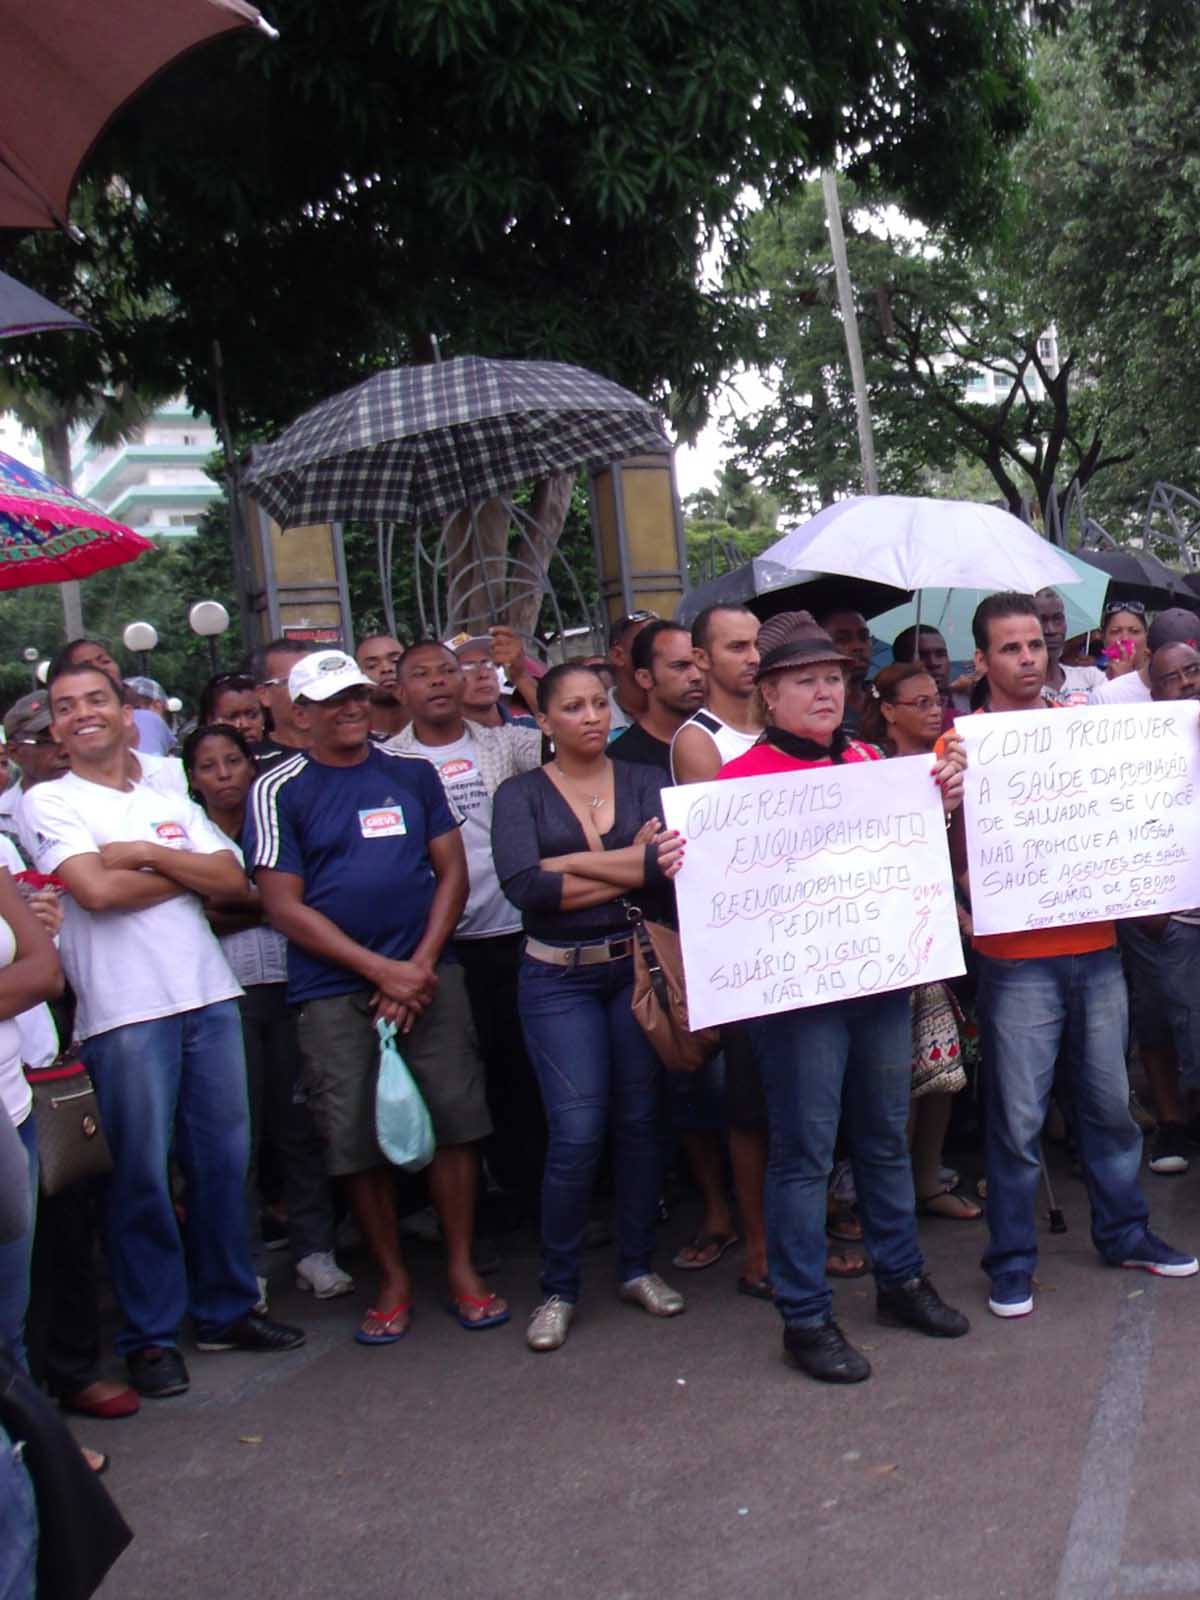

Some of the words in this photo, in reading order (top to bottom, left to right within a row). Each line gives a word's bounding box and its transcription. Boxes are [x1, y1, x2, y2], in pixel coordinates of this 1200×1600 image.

[977, 725, 1051, 766] COMO
[1067, 716, 1179, 748] PROMOVER
[978, 776, 991, 805] A
[1008, 761, 1083, 799] SAÚDE
[366, 816, 398, 828] GREVE
[686, 782, 843, 840] QUEREMOS
[978, 815, 1004, 835] DE
[1015, 801, 1103, 829] SALVADOR
[1110, 796, 1135, 813] SE
[1144, 784, 1193, 811] VOCÊ
[729, 812, 926, 866] ENQUADRAMENTO
[980, 840, 1014, 867] NÃO
[711, 865, 912, 920] REENQUADRAMENTO
[982, 862, 1049, 897] SAÚDE
[1059, 856, 1128, 883] AGENTES
[1132, 852, 1153, 866] DE
[1103, 880, 1121, 895] DE
[769, 901, 881, 943] PEDIMOS
[709, 947, 796, 991] SALÁRIO
[804, 936, 881, 968] DIGNO
[763, 978, 803, 1005] NÃO
[816, 971, 846, 991] AO
[858, 953, 910, 992] 0%
